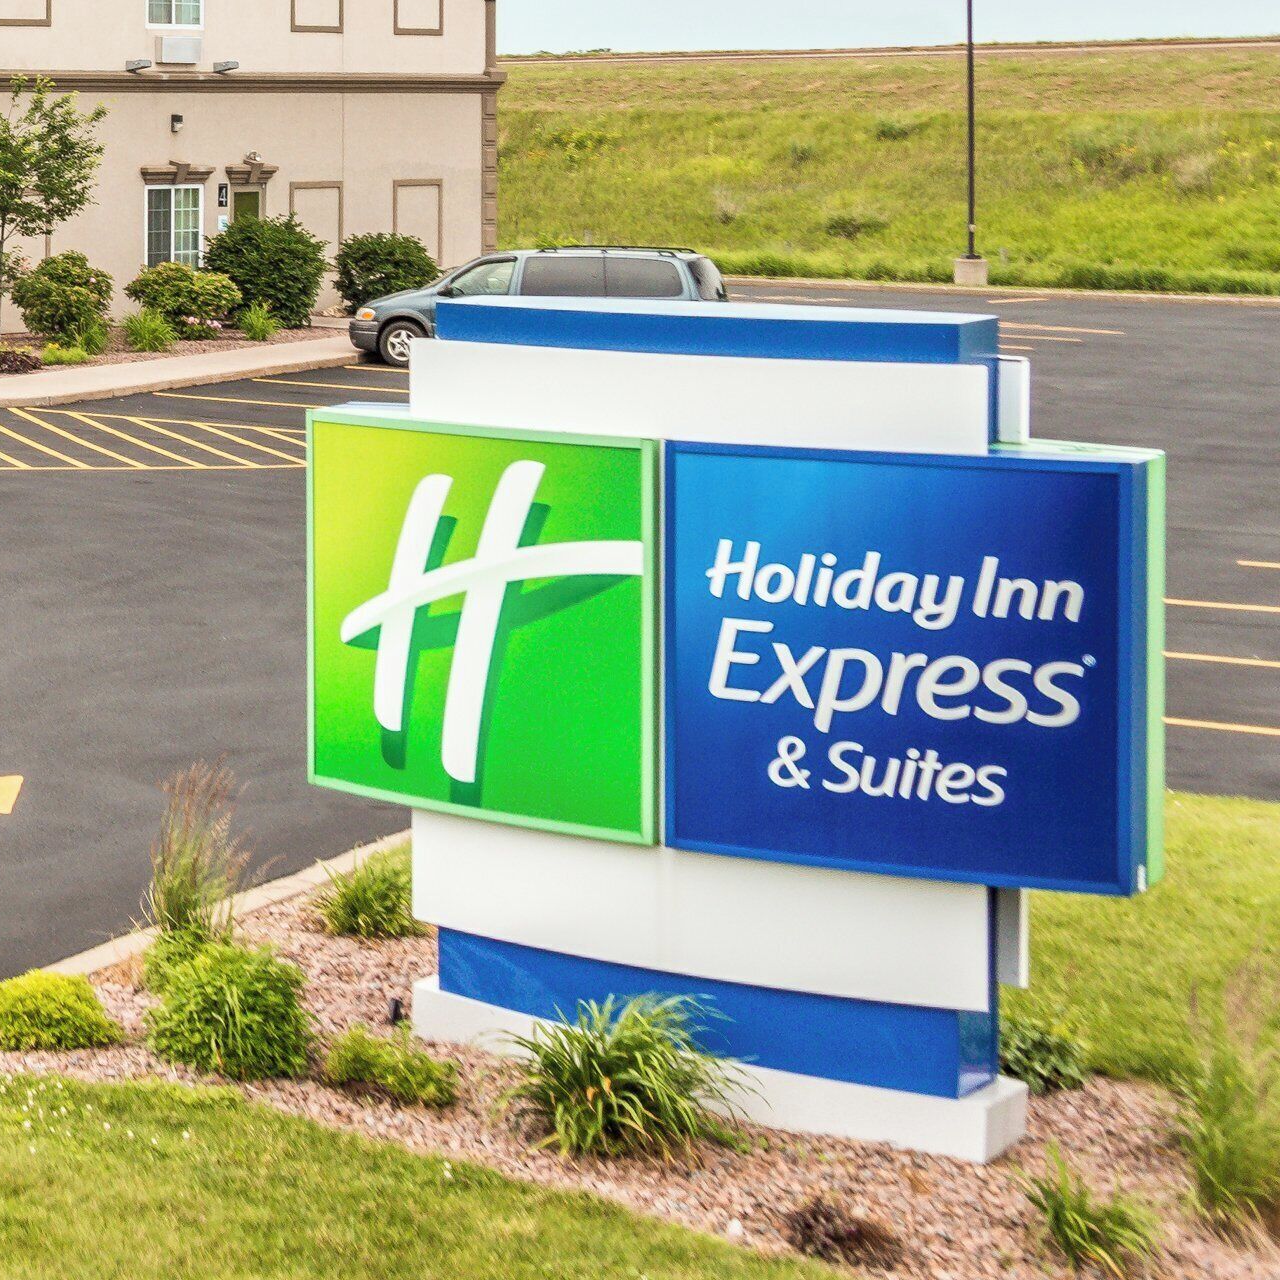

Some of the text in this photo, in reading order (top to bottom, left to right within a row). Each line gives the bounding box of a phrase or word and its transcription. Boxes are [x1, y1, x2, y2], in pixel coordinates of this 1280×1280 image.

[219, 187, 227, 206] 4
[705, 538, 1084, 630] Holiday Inn
[707, 617, 1085, 733] Express
[767, 734, 1008, 807] & Suites
